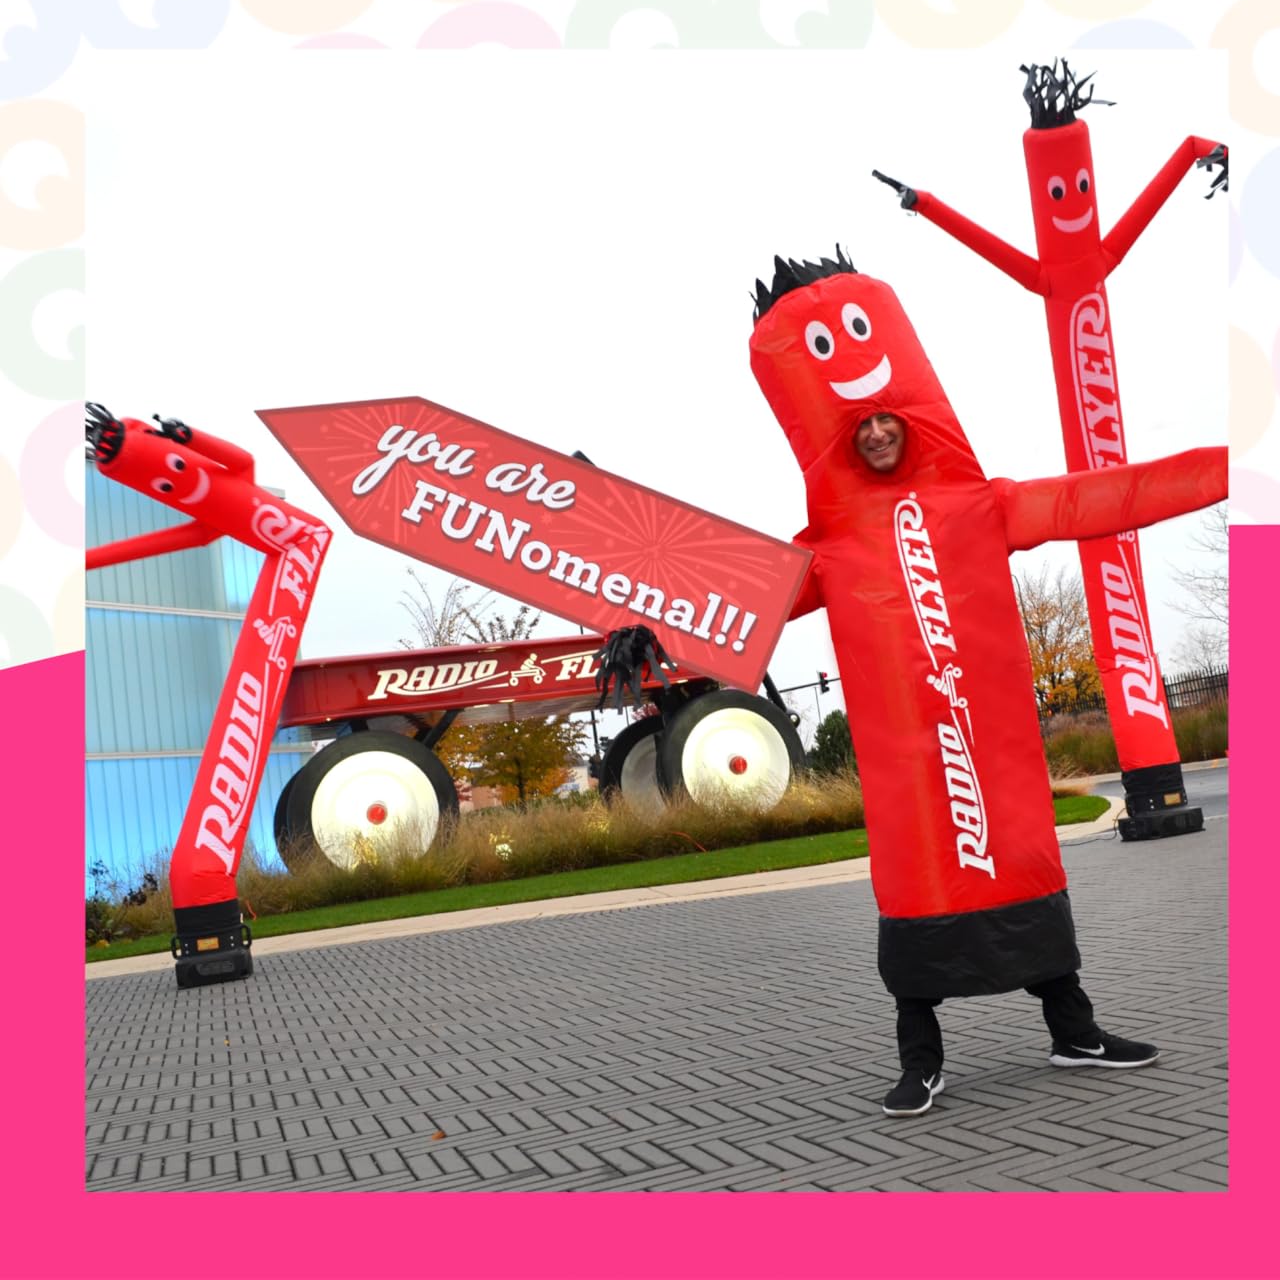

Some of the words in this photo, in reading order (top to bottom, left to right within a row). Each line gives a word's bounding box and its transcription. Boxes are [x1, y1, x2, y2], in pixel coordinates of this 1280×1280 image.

[352, 424, 475, 495] you
[485, 462, 576, 509] are
[401, 479, 758, 653] FUNomenal!!
[894, 498, 956, 653] FLYER
[367, 659, 499, 700] RADIO
[196, 670, 263, 875] RADIO
[937, 723, 996, 879] RADIO
